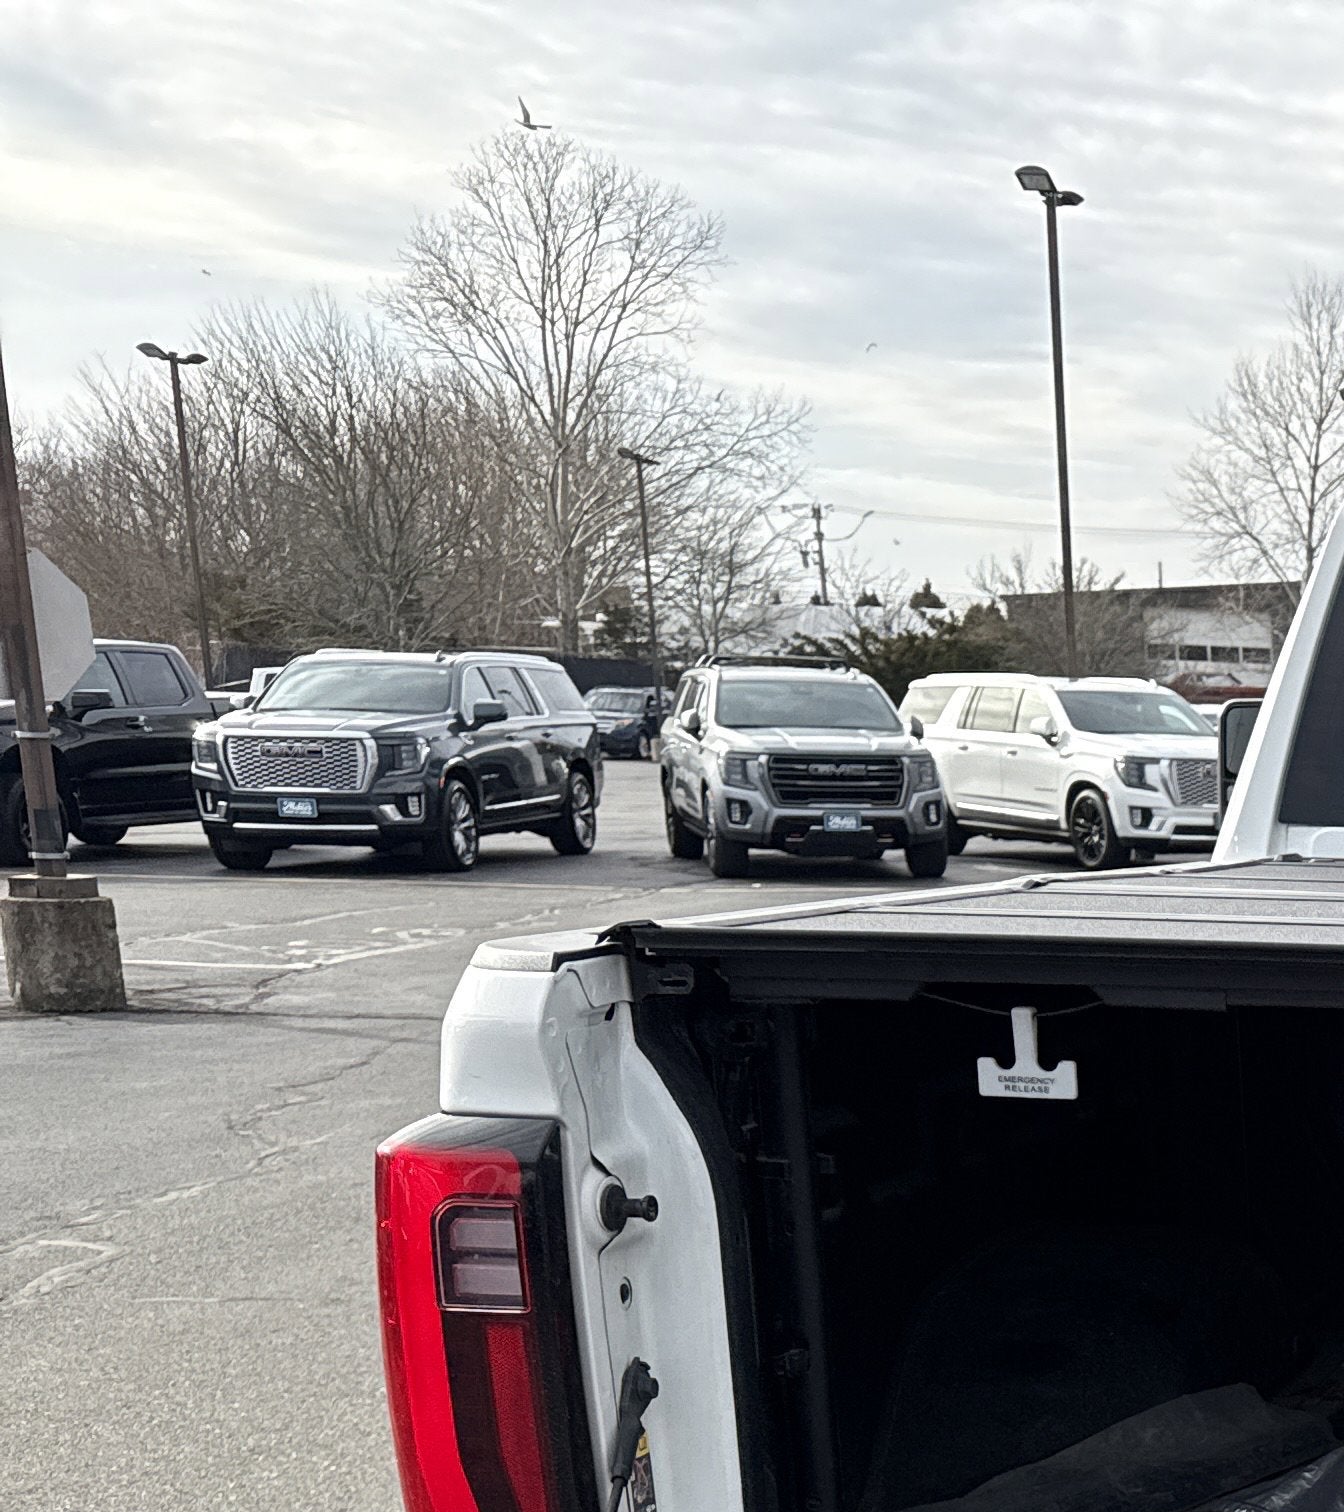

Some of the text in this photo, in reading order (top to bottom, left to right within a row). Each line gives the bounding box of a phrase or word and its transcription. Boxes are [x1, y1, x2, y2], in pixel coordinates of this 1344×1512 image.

[261, 745, 322, 758] GMC
[808, 763, 867, 777] GMC
[997, 1075, 1055, 1085] EMERGENCY
[1004, 1084, 1050, 1094] RELEASE
